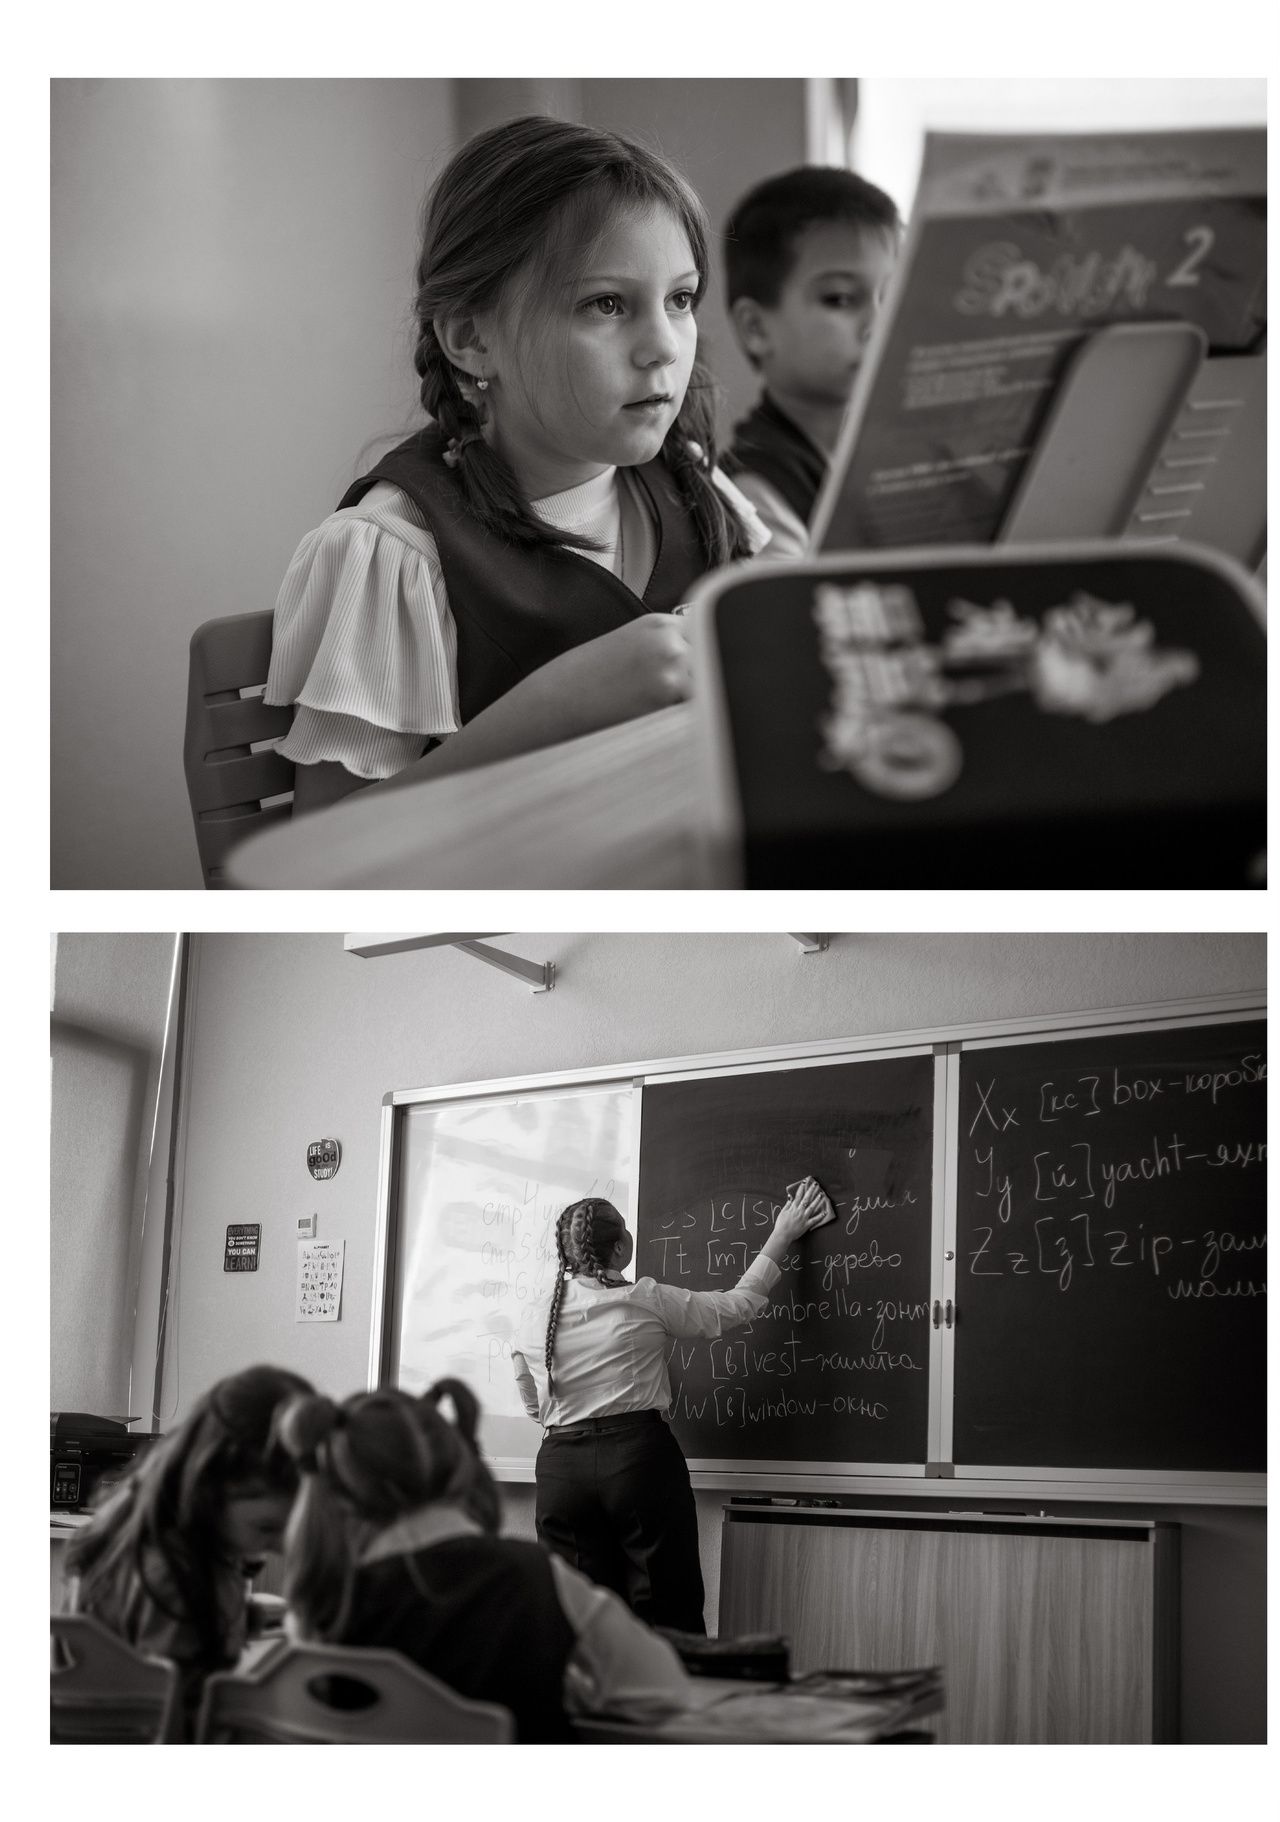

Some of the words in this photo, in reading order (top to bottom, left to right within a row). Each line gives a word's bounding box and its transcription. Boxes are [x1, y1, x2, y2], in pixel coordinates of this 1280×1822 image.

[1164, 224, 1216, 289] 2
[310, 1145, 321, 1156] LIFE
[228, 1248, 241, 1256] YOU
[242, 1248, 256, 1256] CAN
